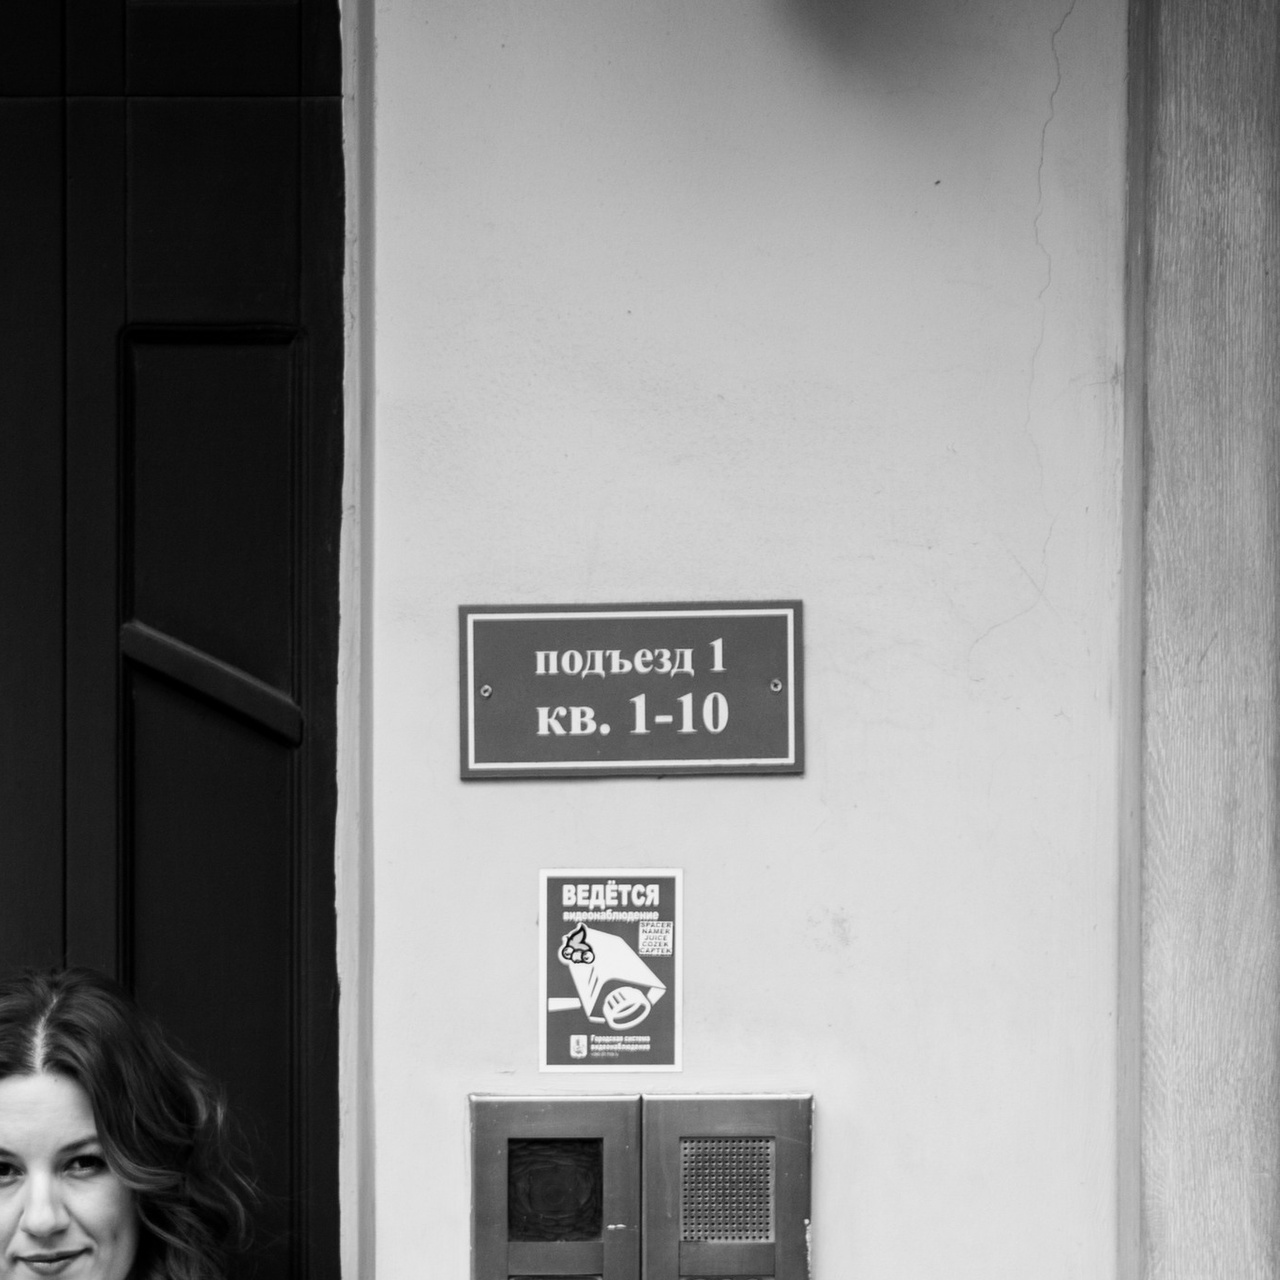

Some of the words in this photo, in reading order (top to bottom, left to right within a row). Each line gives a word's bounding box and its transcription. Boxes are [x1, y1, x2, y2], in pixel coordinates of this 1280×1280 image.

[535, 647, 695, 679] подъезд
[708, 637, 727, 672] 1
[536, 704, 611, 735] кв.
[628, 691, 729, 733] 1-10
[562, 879, 660, 910] ВЕДЁТСЯ
